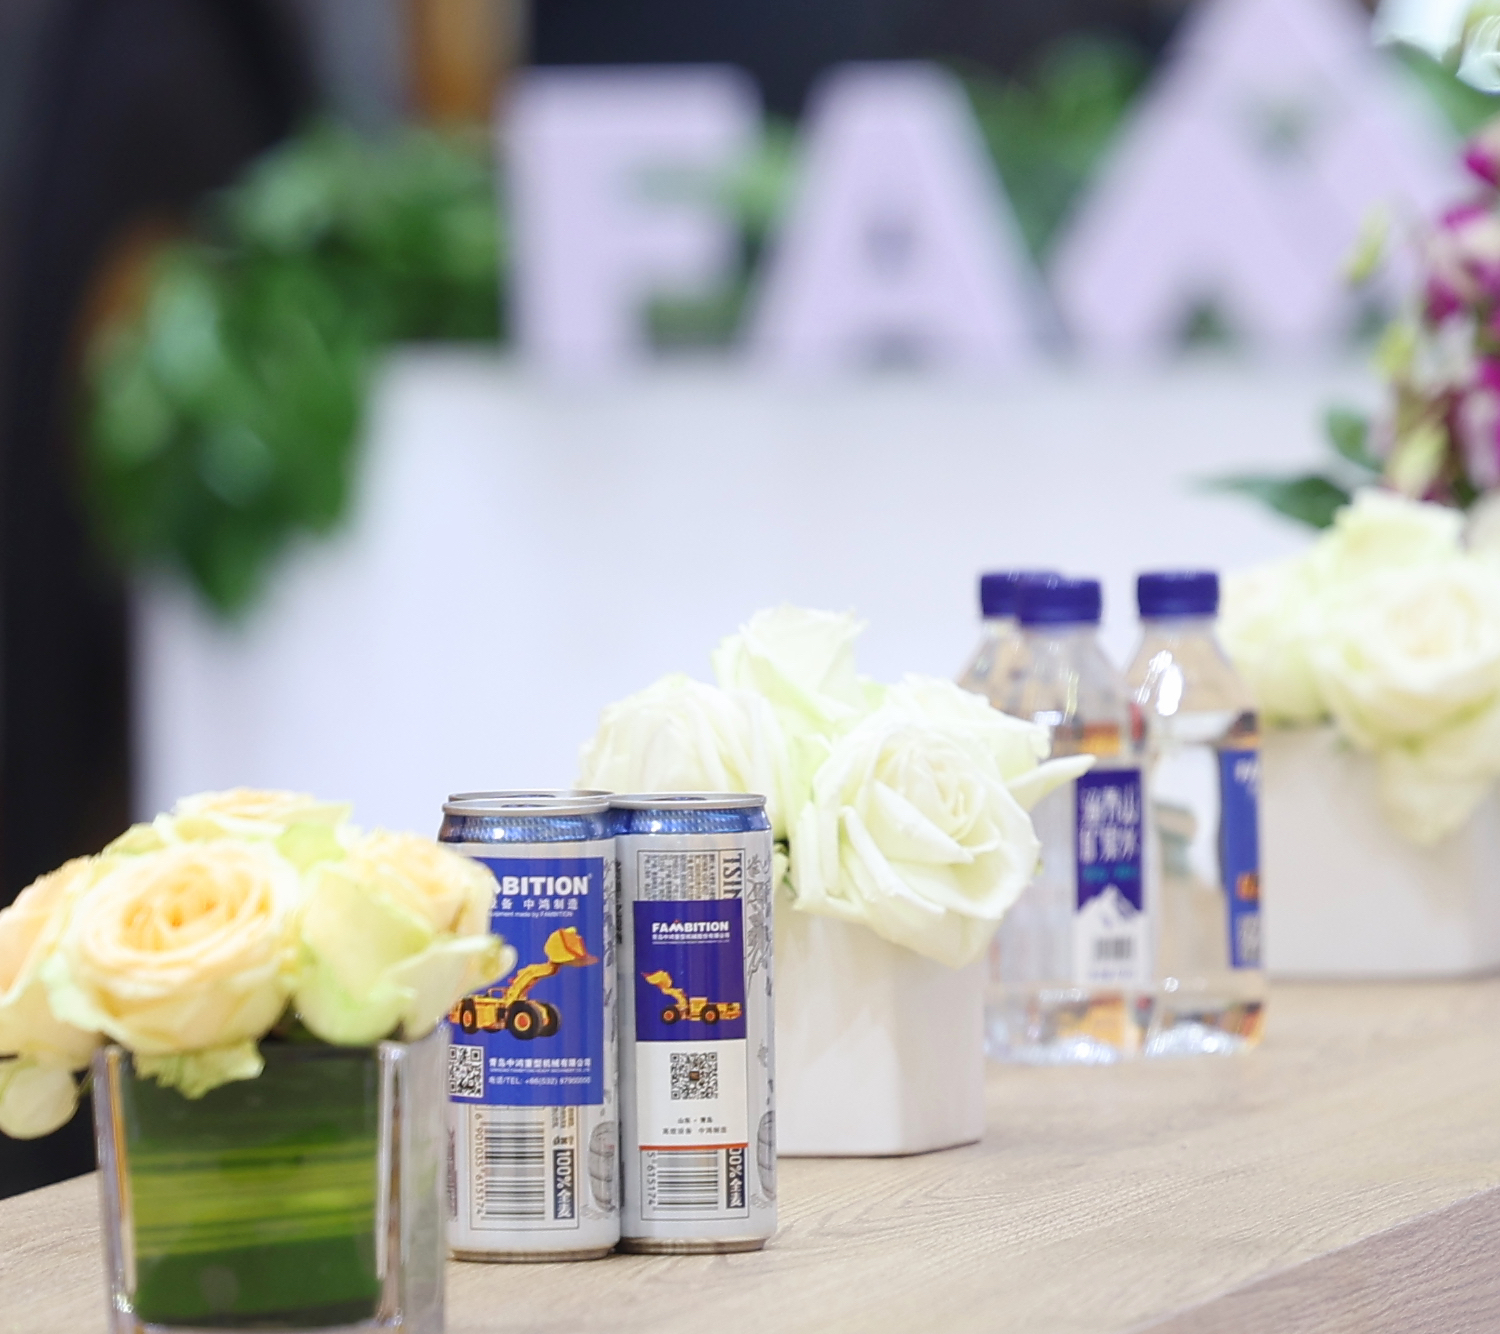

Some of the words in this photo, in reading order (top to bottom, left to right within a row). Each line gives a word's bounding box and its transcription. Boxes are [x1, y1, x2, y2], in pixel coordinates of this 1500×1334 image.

[500, 876, 589, 896] BITION
[652, 920, 729, 933] FAMBITION
[729, 1148, 743, 1207] 00%全麦
